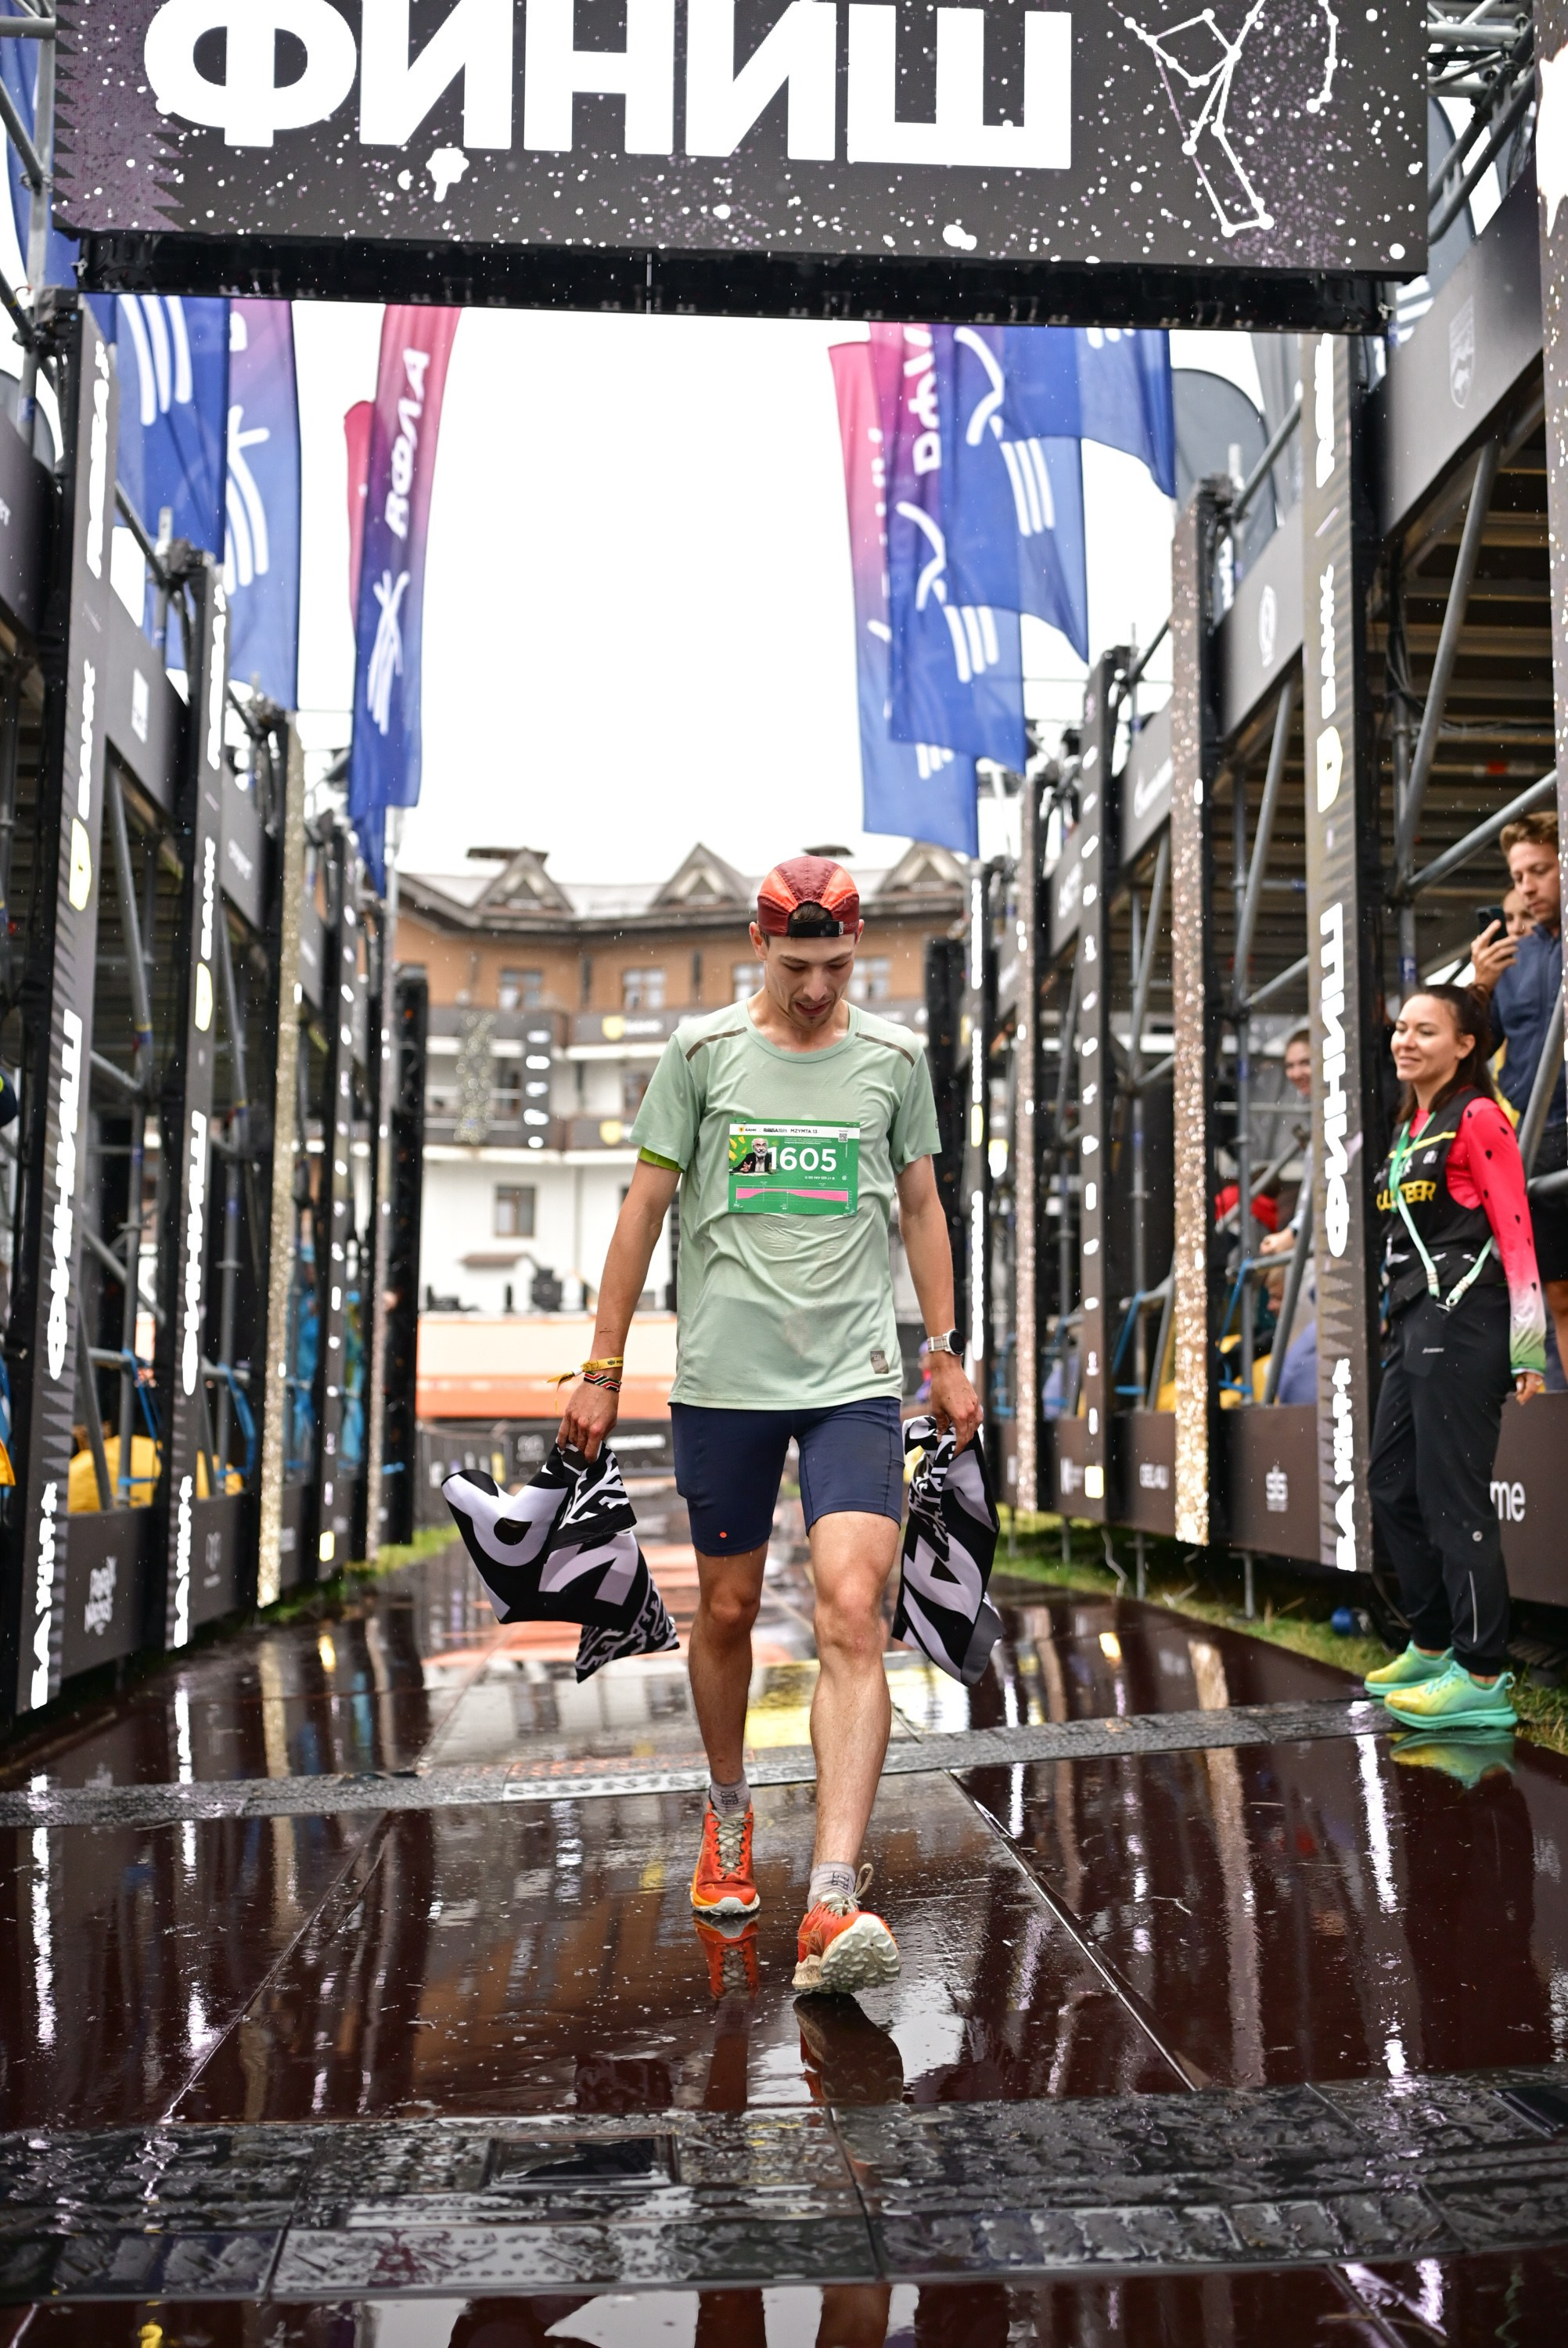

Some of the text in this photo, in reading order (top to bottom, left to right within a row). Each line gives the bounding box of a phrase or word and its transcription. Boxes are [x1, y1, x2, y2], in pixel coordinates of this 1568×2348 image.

[144, 0, 1072, 169] ФИНИШ
[768, 1147, 836, 1172] 1605
[1319, 902, 1349, 1258] ФИНИШ
